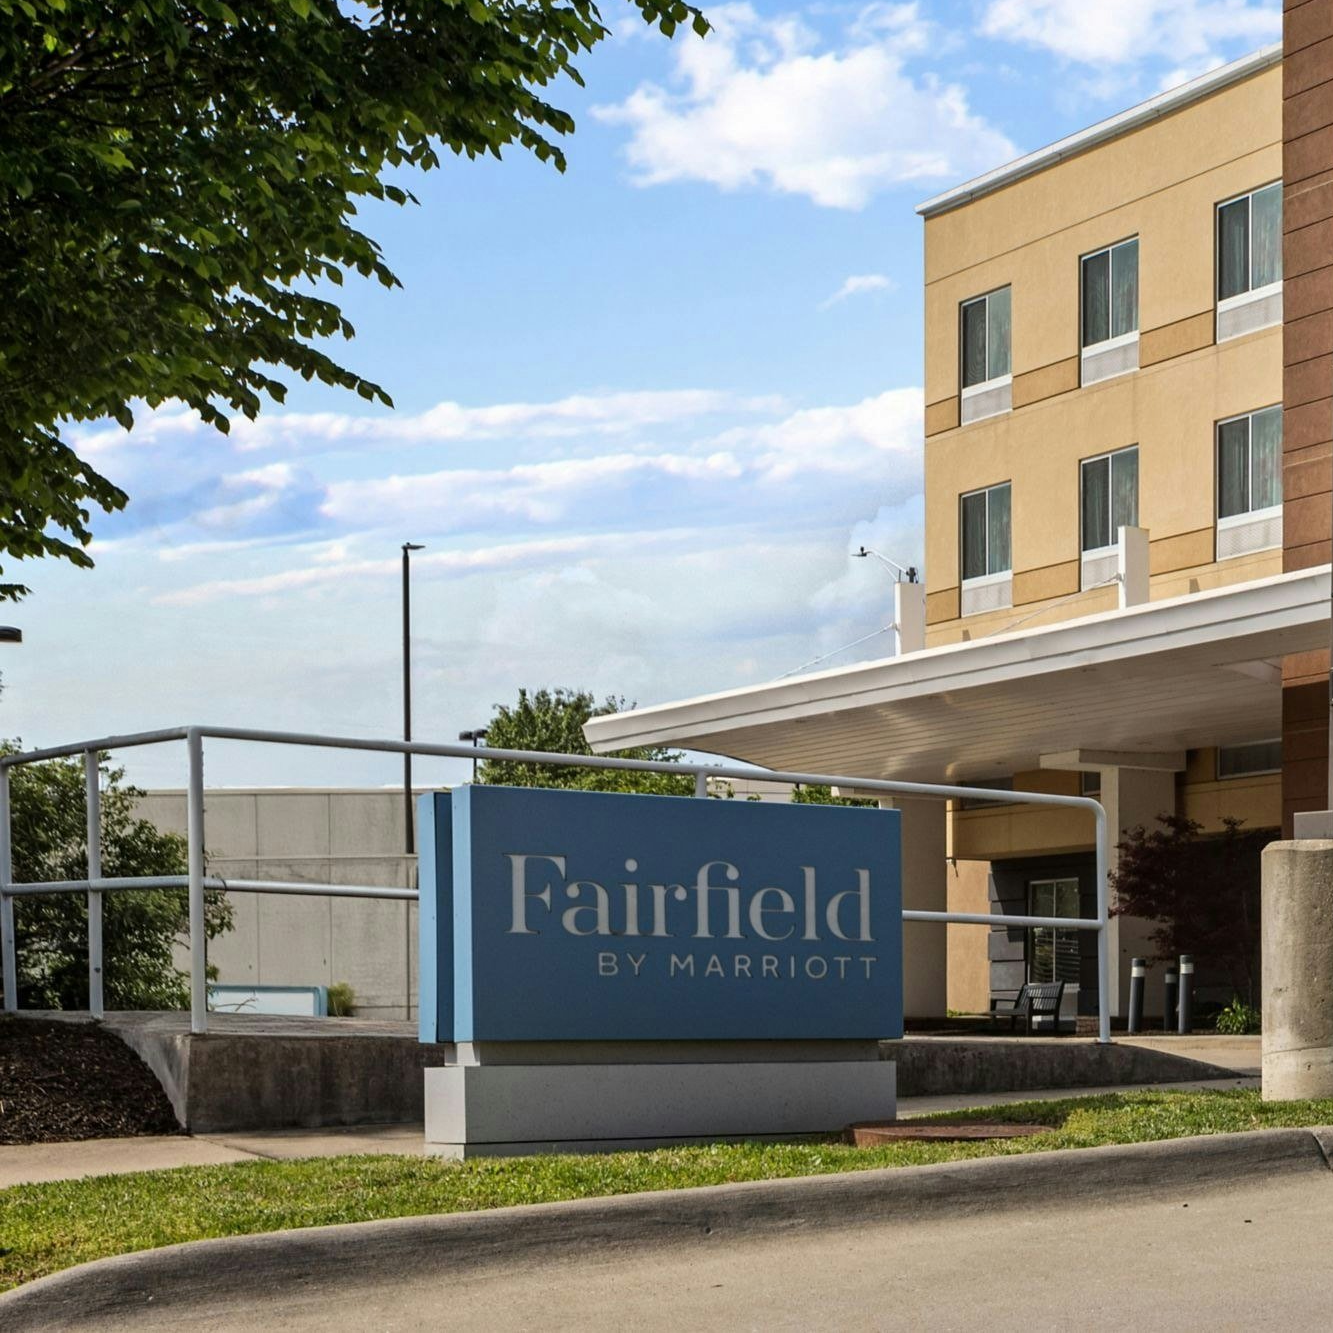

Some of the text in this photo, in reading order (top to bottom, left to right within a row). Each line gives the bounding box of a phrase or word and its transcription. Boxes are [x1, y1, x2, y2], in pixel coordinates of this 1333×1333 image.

[503, 853, 878, 943] Fairfield
[599, 952, 878, 980] BY MARRIOTT
